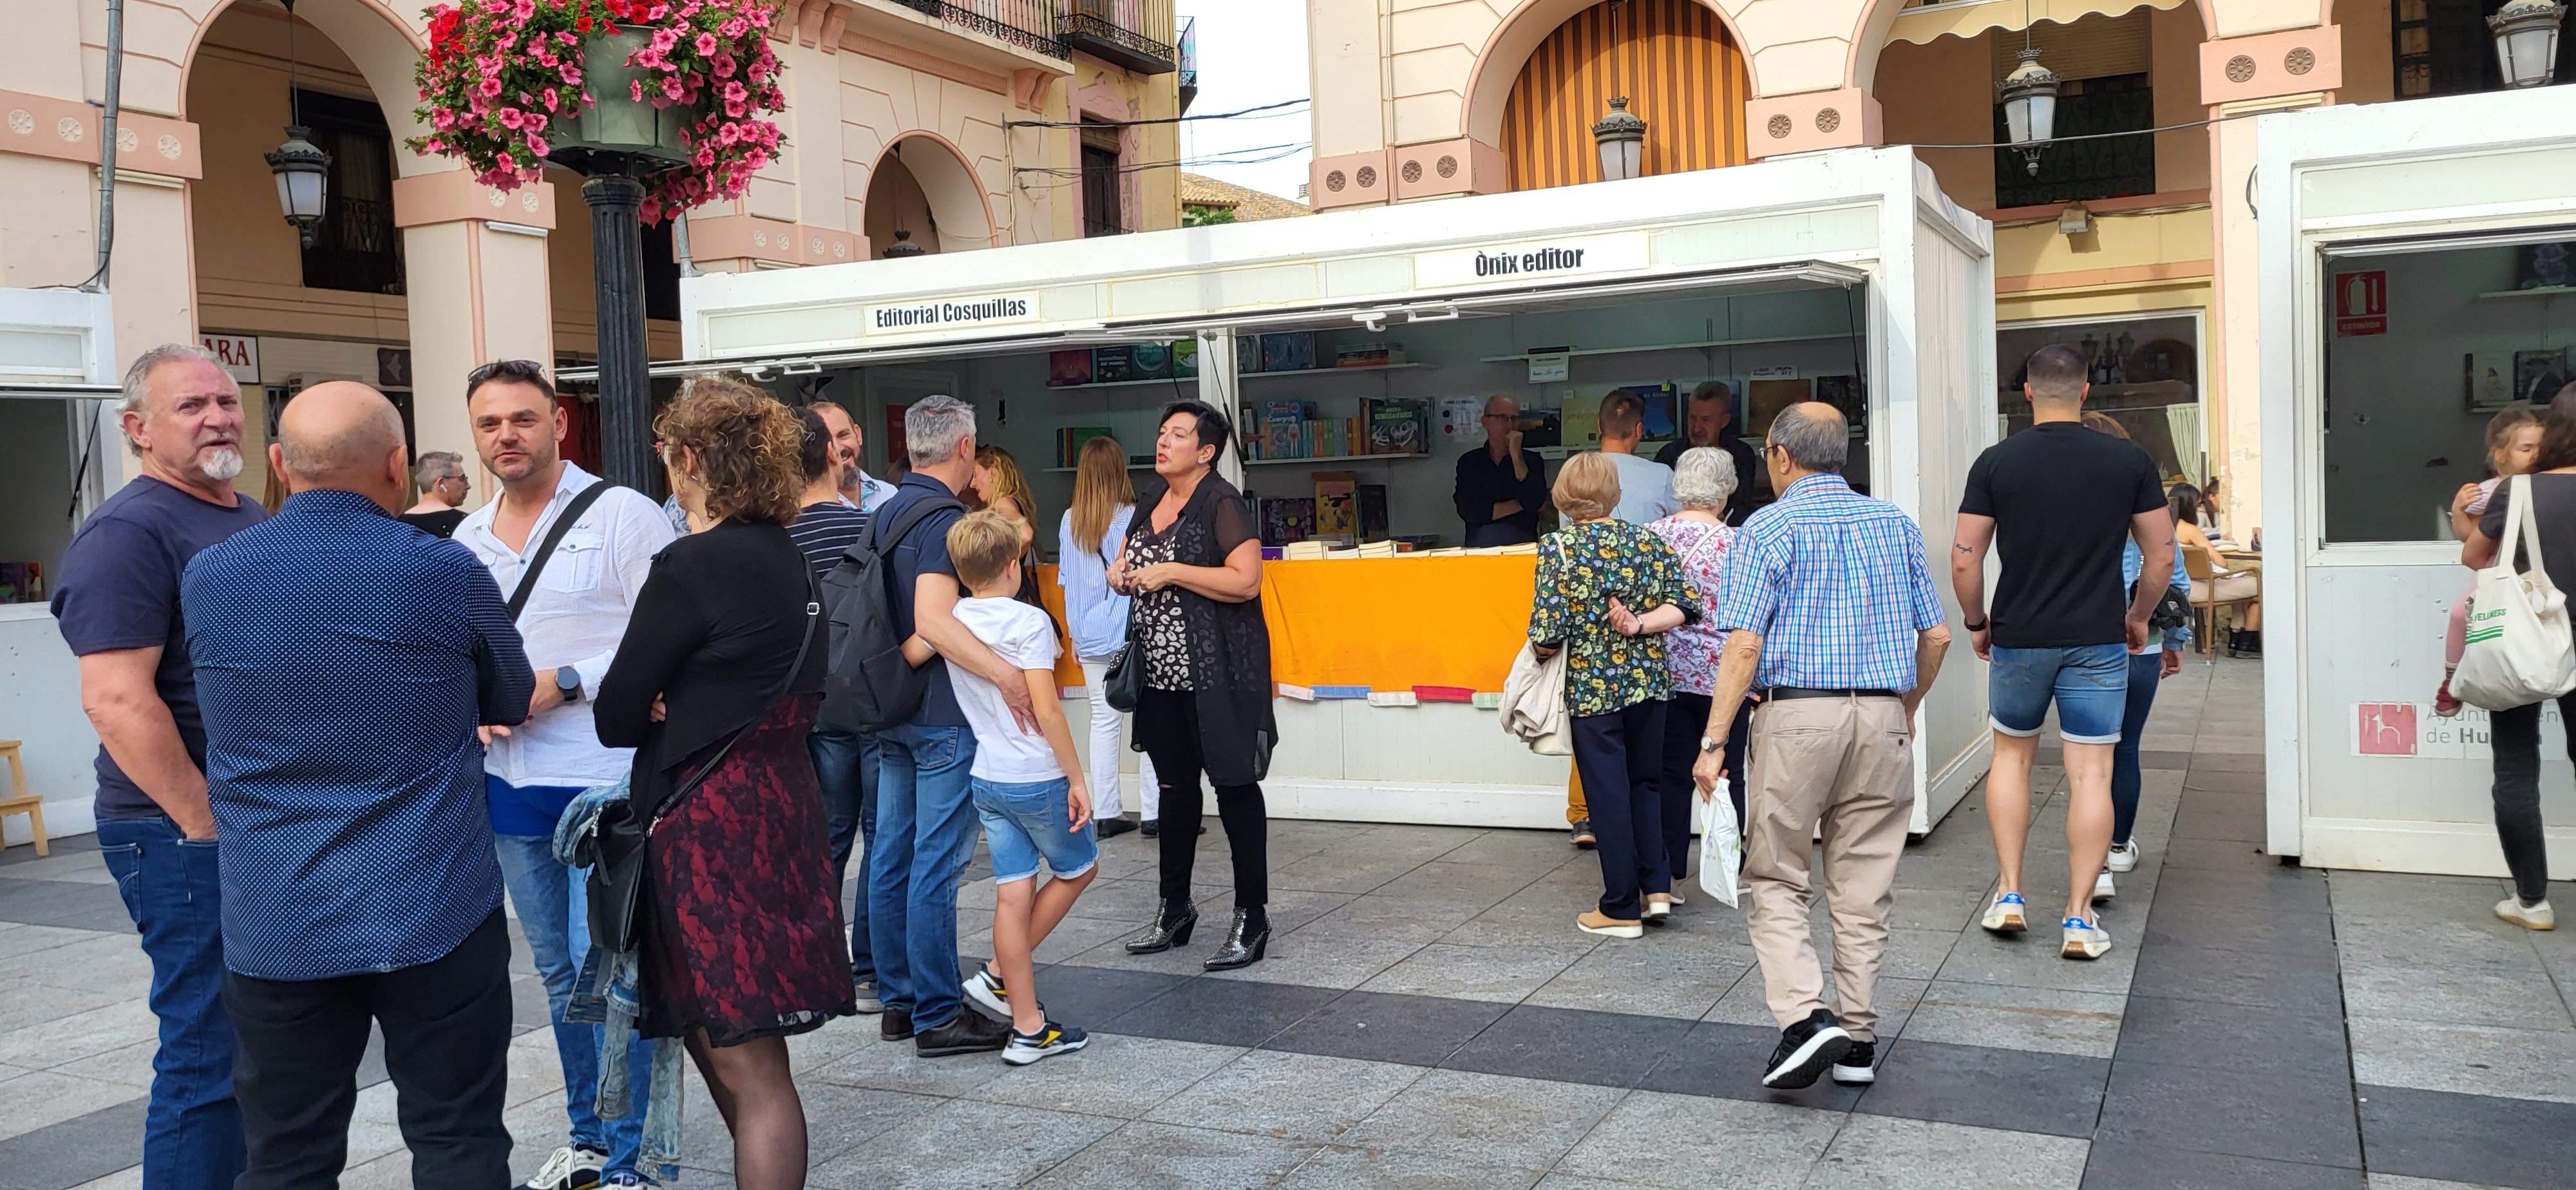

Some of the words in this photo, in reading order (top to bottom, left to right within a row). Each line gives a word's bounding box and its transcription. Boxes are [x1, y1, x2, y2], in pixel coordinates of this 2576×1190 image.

[1475, 250, 1519, 276] Ònix
[1522, 247, 1584, 272] editor
[876, 304, 939, 328] Editorial
[943, 298, 1027, 322] Cosquillas
[2427, 728, 2450, 743] de
